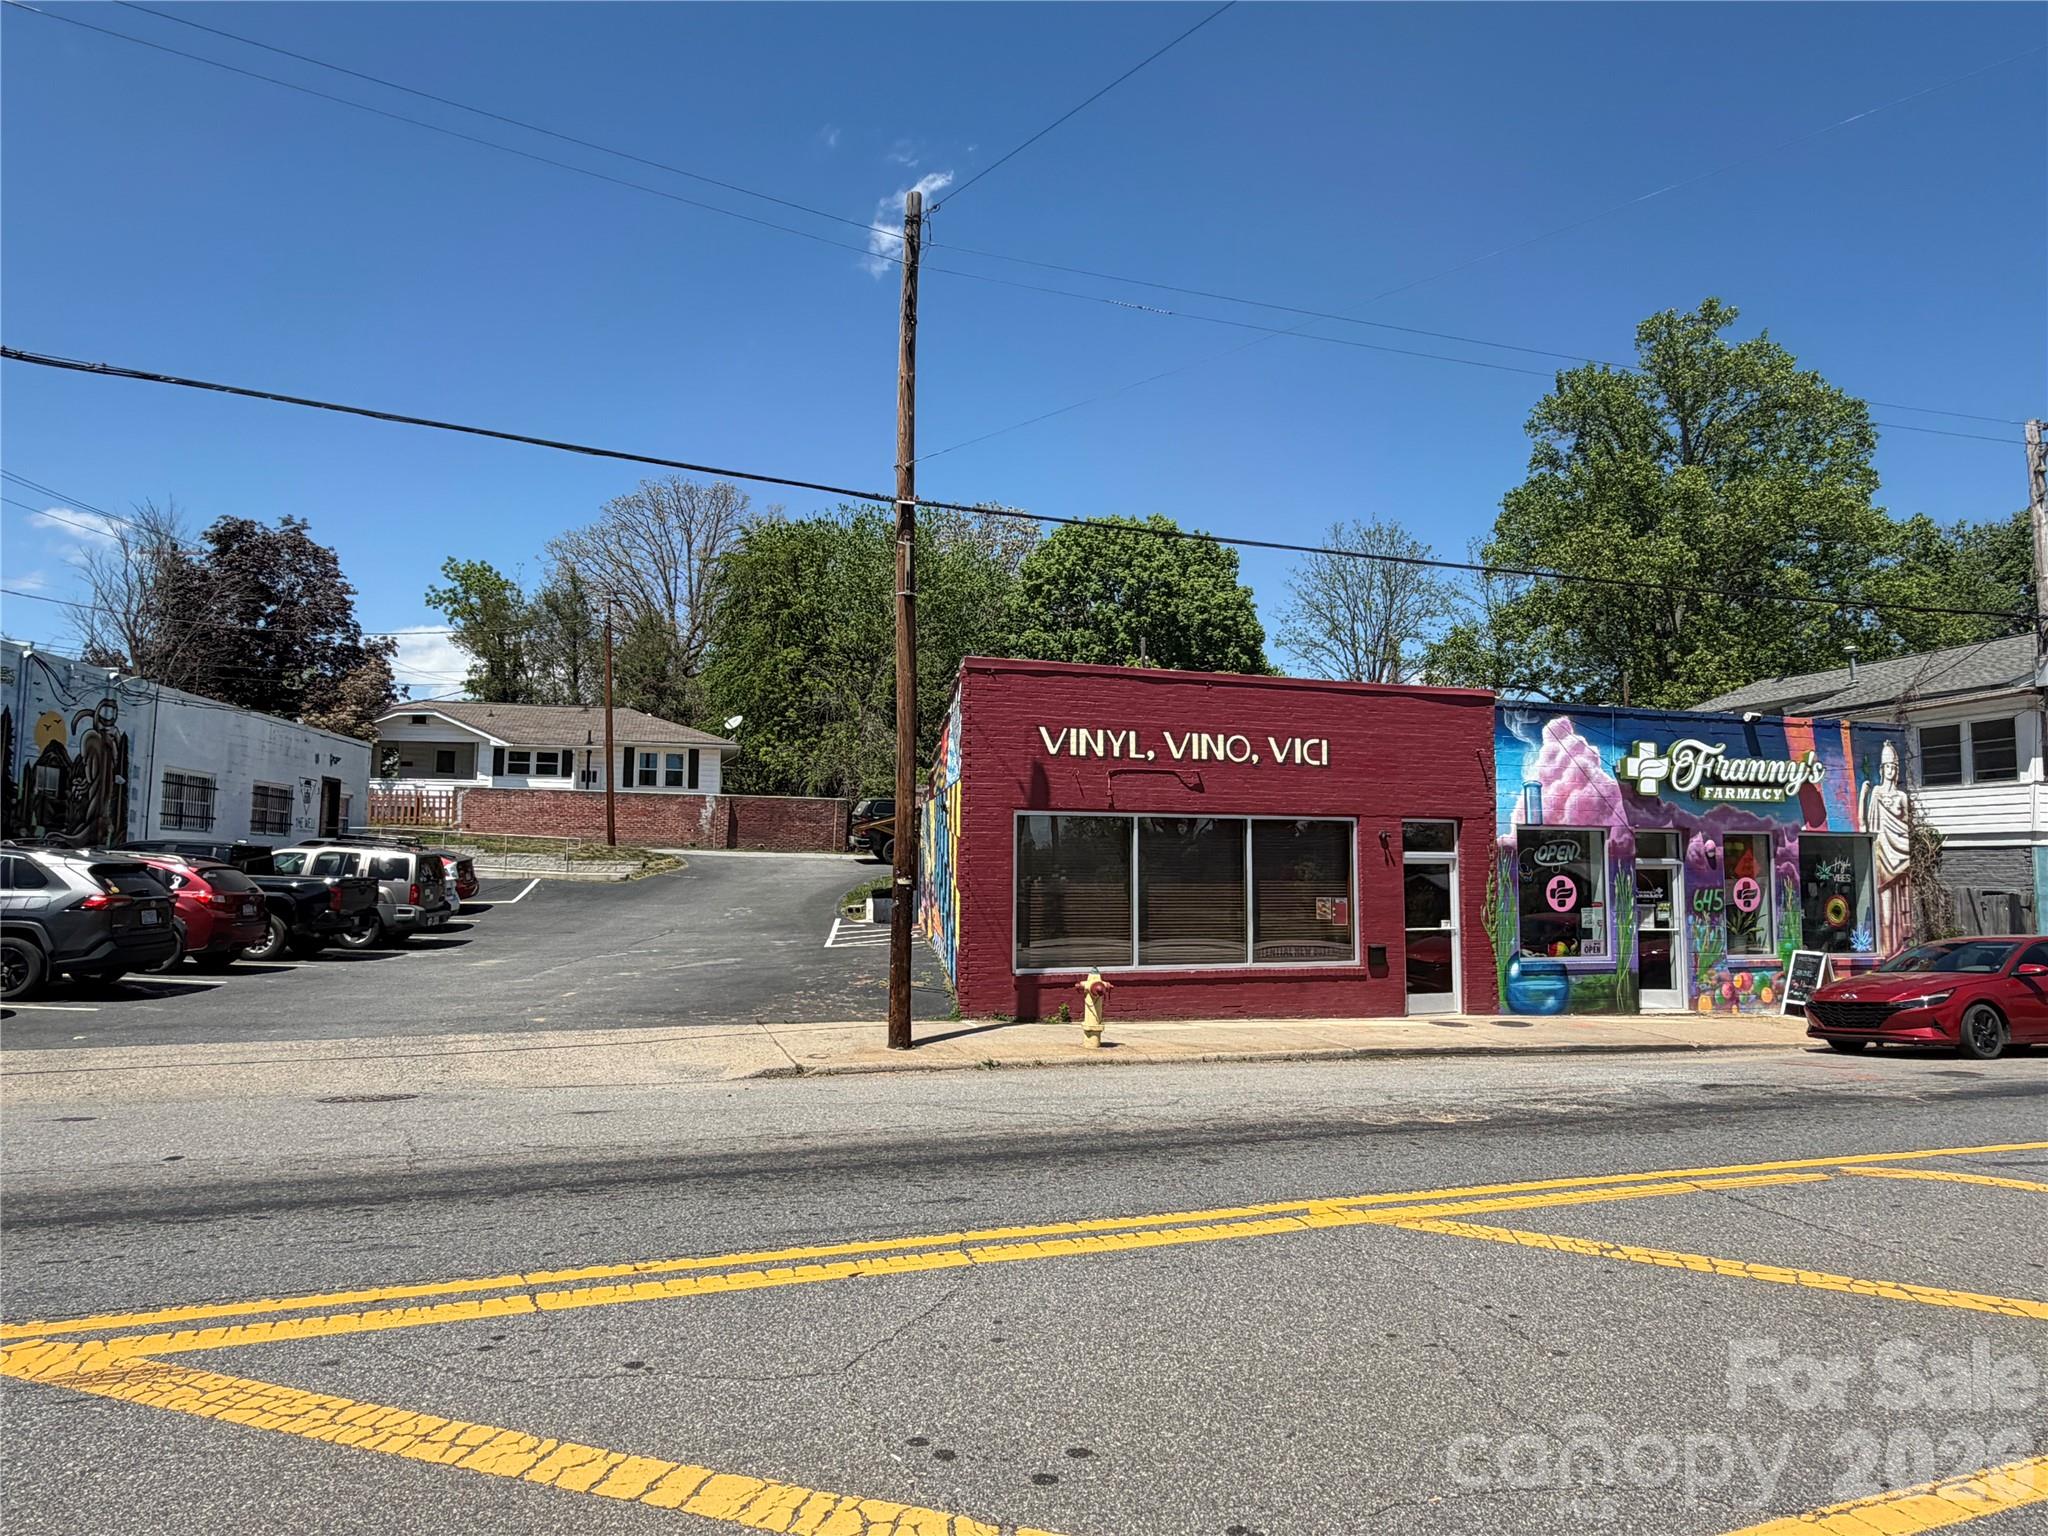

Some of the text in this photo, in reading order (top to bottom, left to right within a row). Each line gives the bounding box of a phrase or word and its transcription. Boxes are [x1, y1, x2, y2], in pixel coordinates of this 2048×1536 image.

[1039, 726, 1328, 766] VINYL, VINO, VICI
[1670, 738, 1826, 796] Franny's
[1703, 786, 1784, 801] FARMACY
[1538, 844, 1576, 861] OPEN
[1692, 888, 1724, 912] 645
[1584, 944, 1601, 954] OPEN
